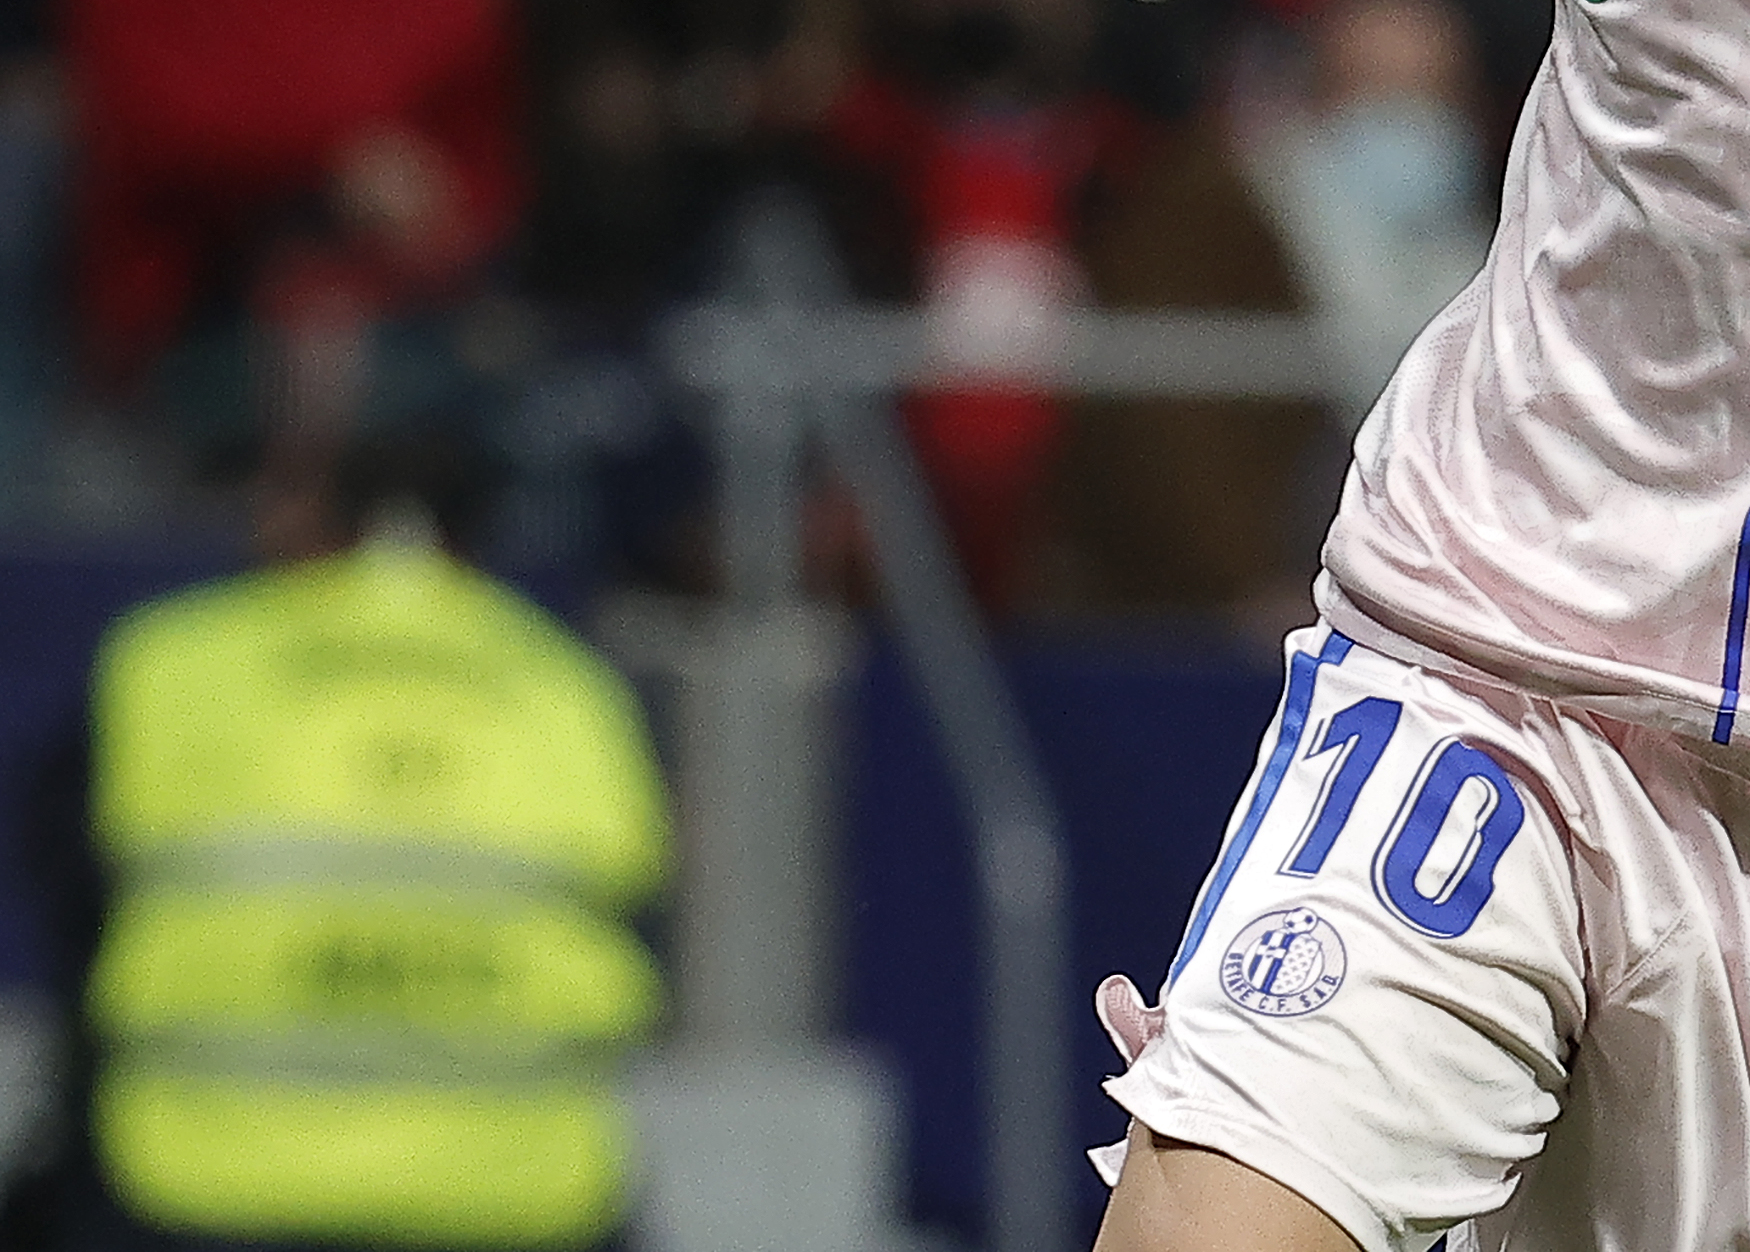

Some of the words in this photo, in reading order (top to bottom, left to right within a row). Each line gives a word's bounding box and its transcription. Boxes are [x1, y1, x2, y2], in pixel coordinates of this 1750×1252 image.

[1275, 695, 1526, 940] 10
[1224, 952, 1255, 1003] GETAFE
[1258, 995, 1292, 1012] C.F.
